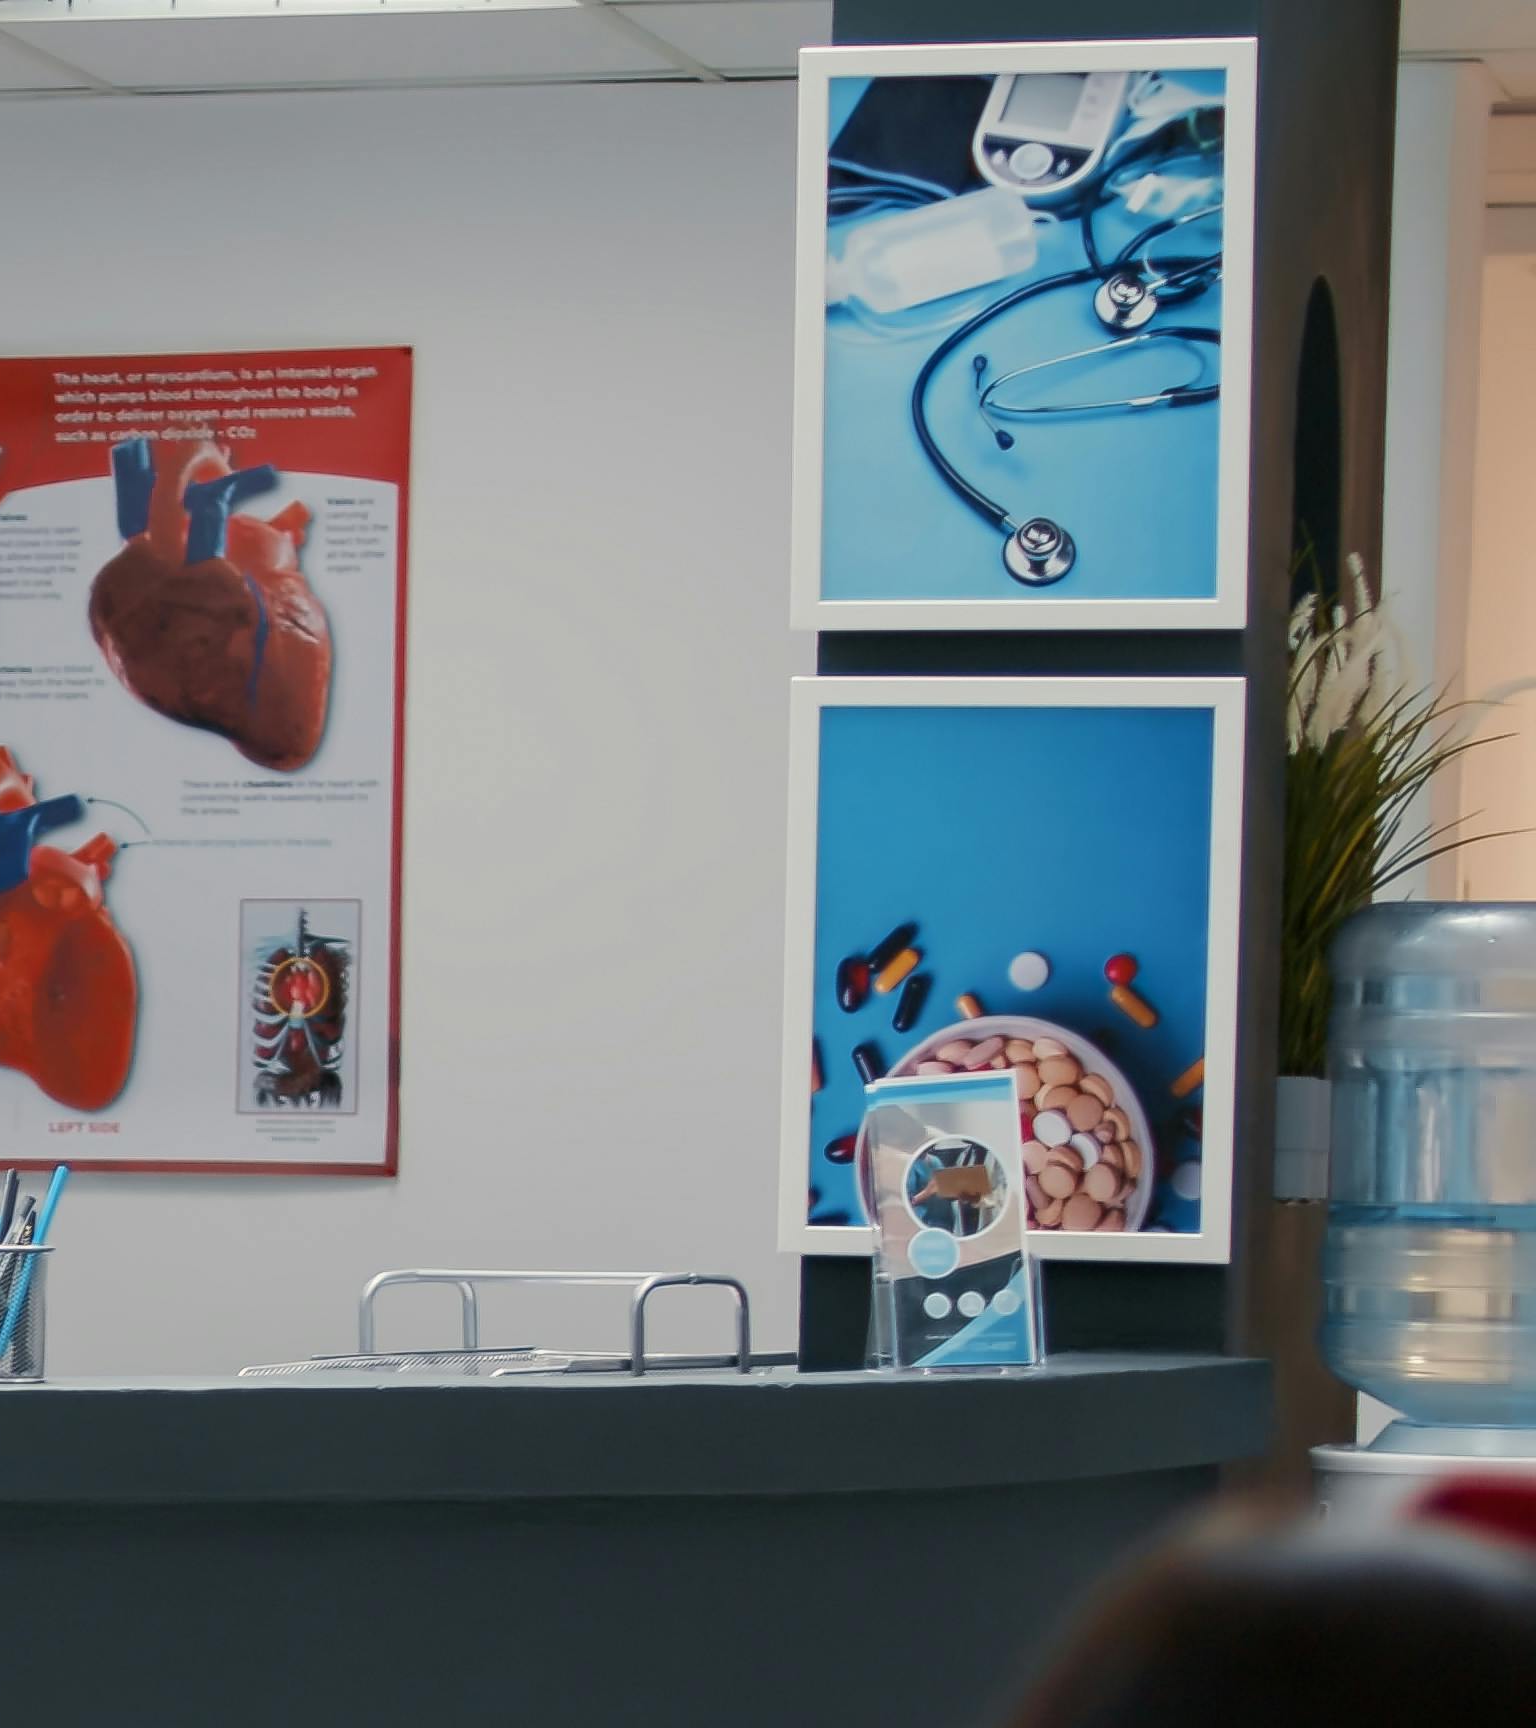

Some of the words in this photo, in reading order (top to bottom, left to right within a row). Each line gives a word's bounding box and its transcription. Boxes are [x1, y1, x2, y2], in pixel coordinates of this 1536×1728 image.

[53, 372, 80, 384] The
[82, 372, 125, 384] heart,
[126, 372, 142, 384] or
[239, 368, 253, 380] is
[255, 368, 274, 380] an
[276, 366, 332, 380] internal
[334, 366, 378, 380] organ
[54, 391, 96, 404] which
[98, 391, 146, 404] pumps
[148, 388, 192, 402] blood
[193, 386, 274, 402] throughout
[275, 386, 301, 399] the
[302, 384, 341, 401] body
[342, 383, 359, 398] in
[54, 409, 94, 423] order
[96, 409, 113, 423] to
[115, 408, 164, 422] deliver
[166, 408, 221, 423] oxygen
[222, 406, 250, 420] and
[253, 406, 307, 420] remove
[309, 405, 356, 418] waste,
[55, 429, 88, 442] such
[90, 430, 107, 442] as
[48, 1122, 83, 1133] LEFT
[88, 1122, 121, 1133] SIDE
